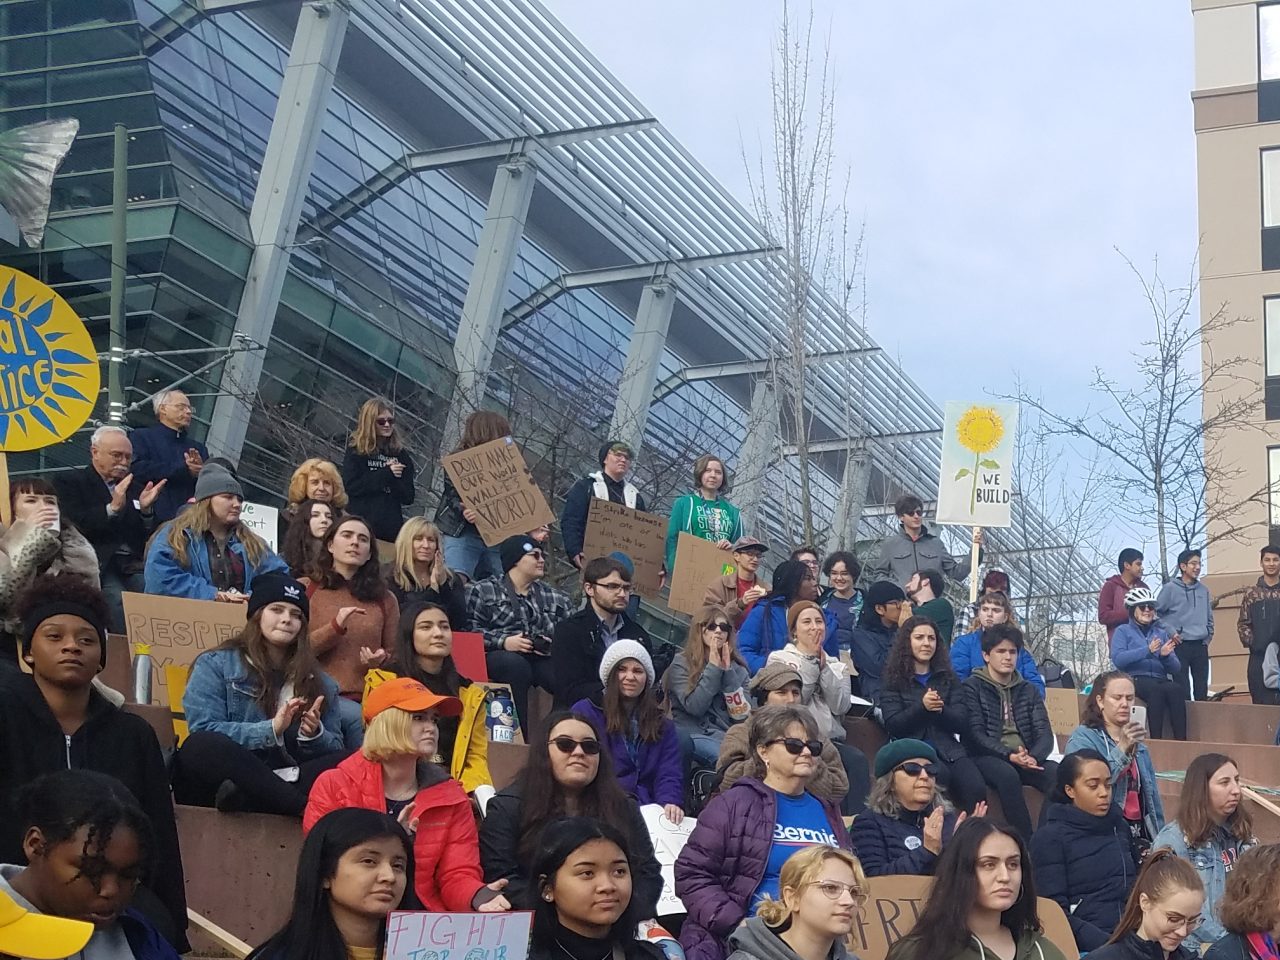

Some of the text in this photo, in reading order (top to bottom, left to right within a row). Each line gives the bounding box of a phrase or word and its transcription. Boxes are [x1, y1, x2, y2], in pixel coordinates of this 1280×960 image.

[485, 445, 517, 467] MAKE
[460, 473, 488, 491] OUR
[983, 473, 1001, 485] WE
[976, 488, 1010, 504] BUILD
[476, 490, 536, 530] WORLD
[774, 823, 839, 847] Bernie
[391, 911, 513, 955] FIGHT
